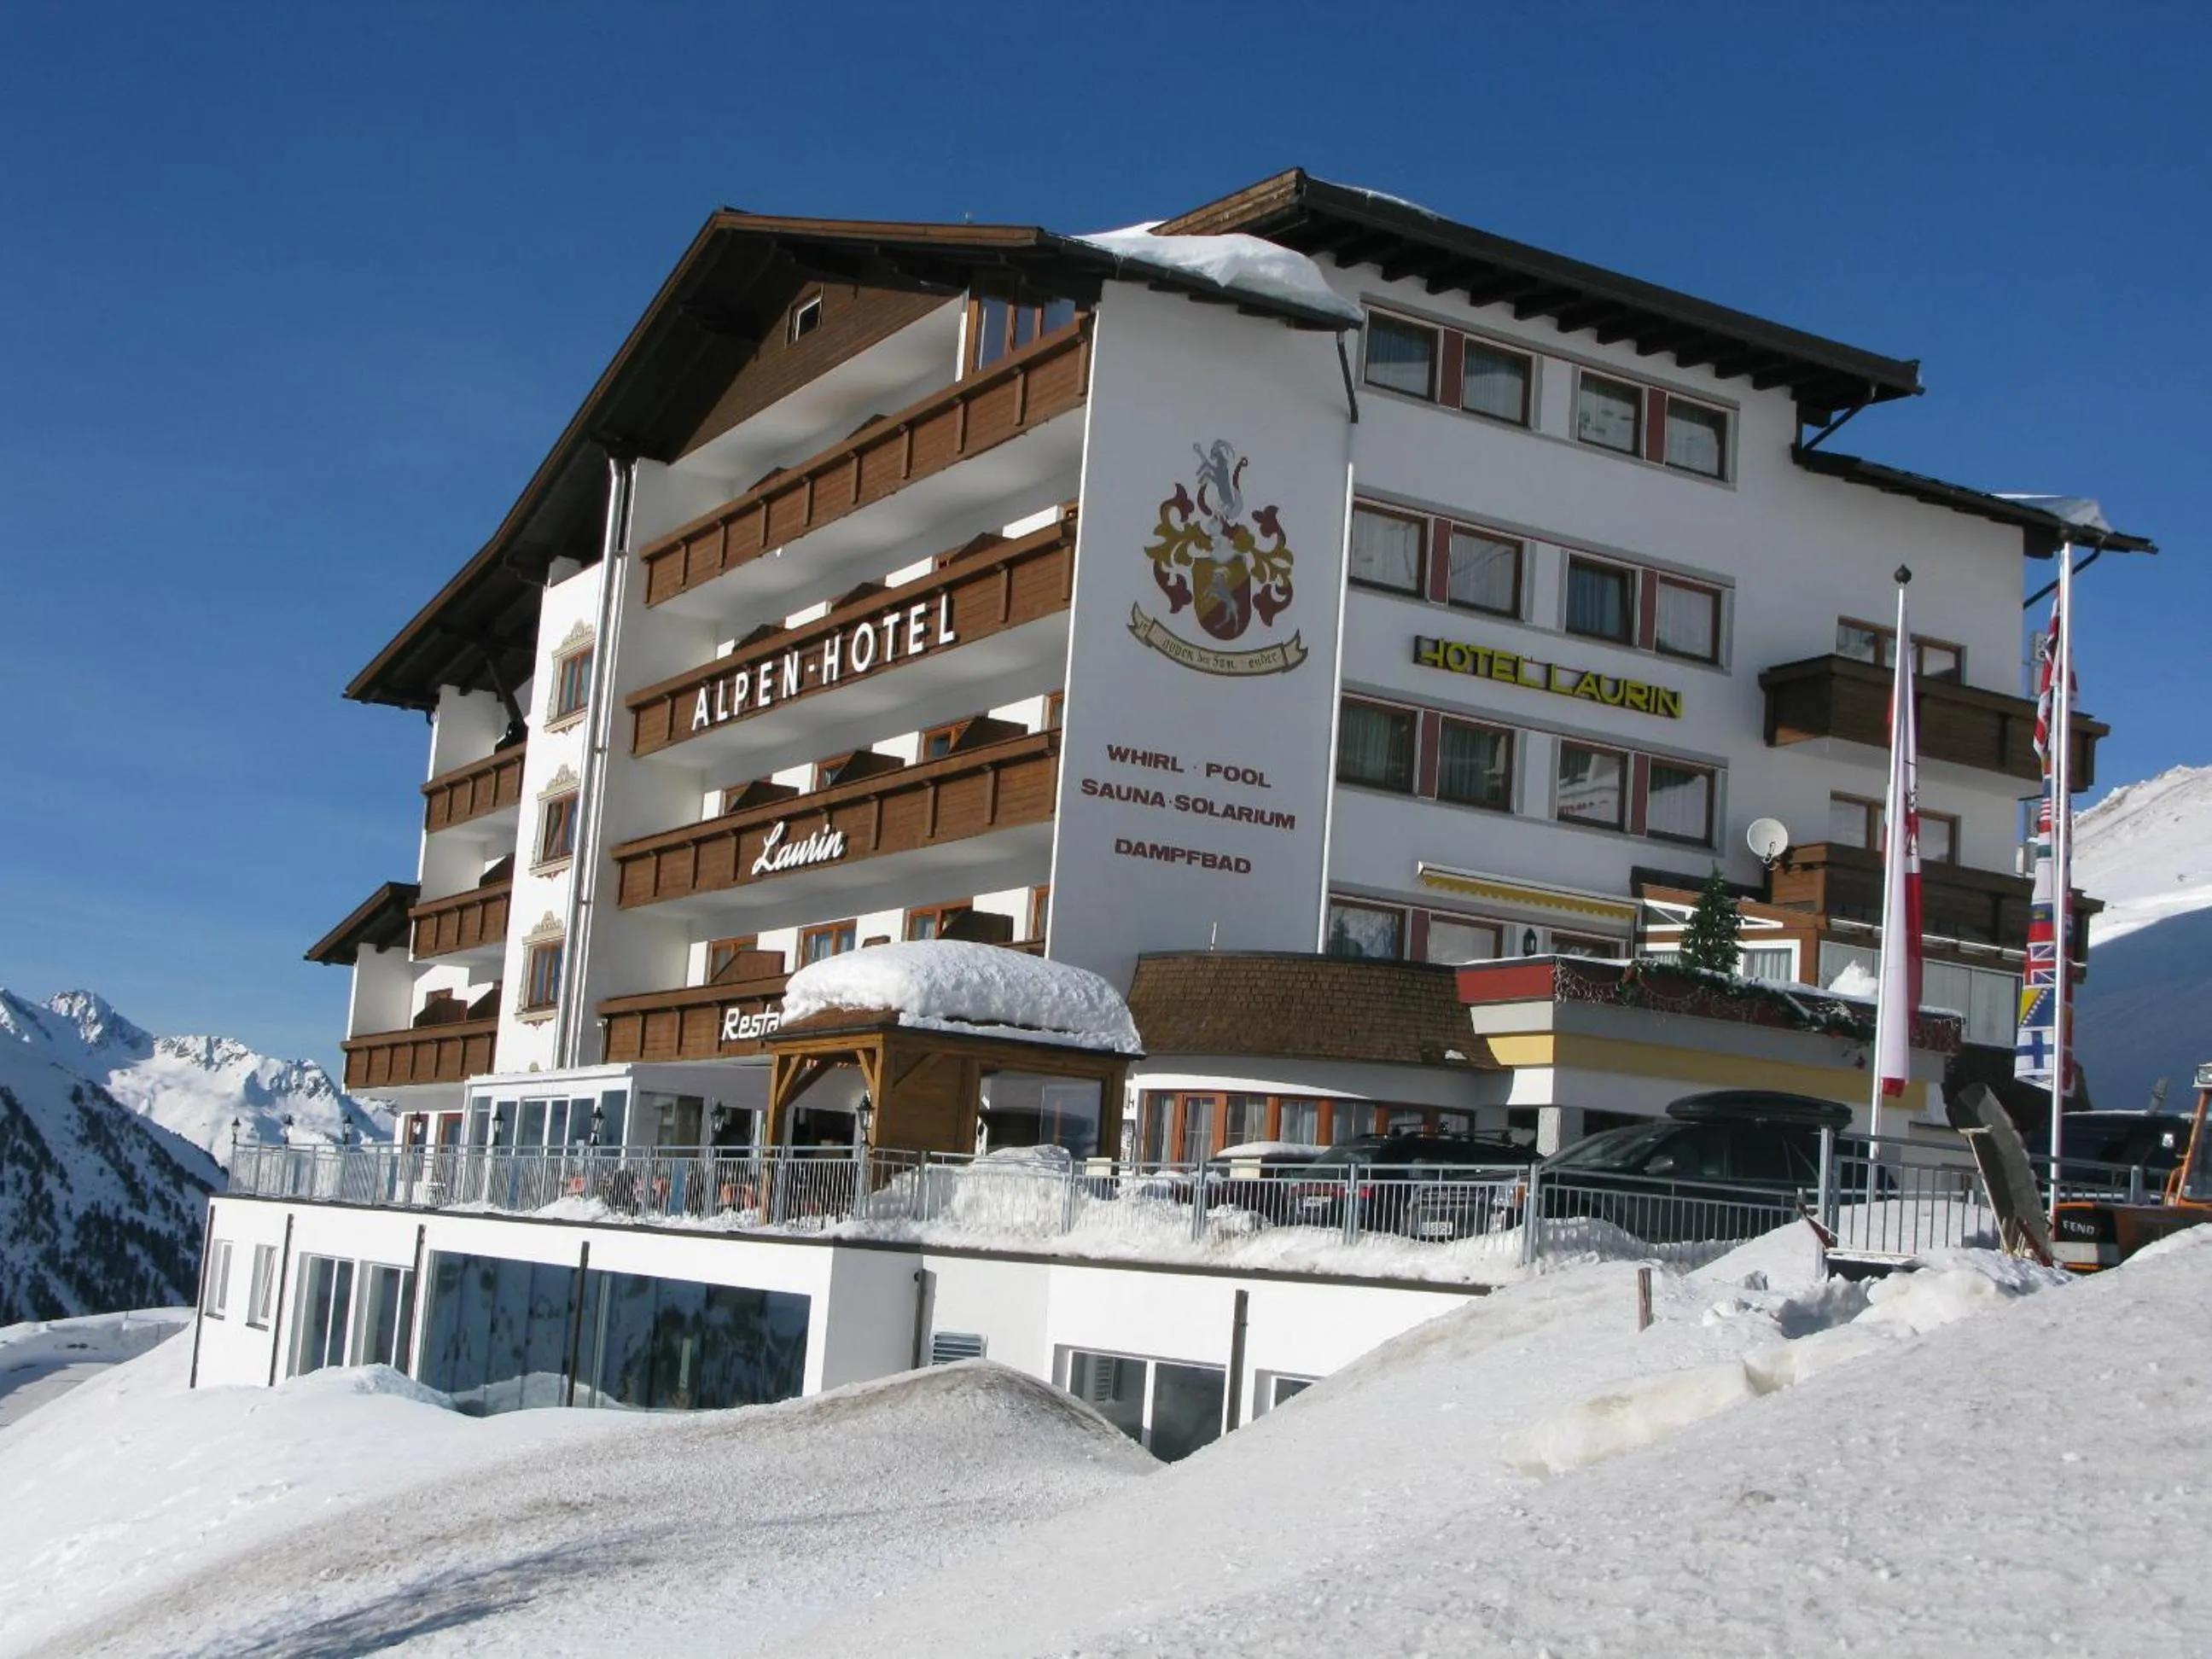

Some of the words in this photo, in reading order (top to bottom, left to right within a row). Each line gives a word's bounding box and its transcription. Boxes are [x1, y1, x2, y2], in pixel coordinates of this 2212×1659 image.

[1413, 635, 1545, 689] HOTEL
[1546, 662, 1682, 719] LAURIN
[1107, 744, 1185, 772] WHIRL
[1205, 762, 1272, 789] POOL
[752, 820, 845, 876] Laurin
[1115, 838, 1252, 875] DAMPFBAD
[721, 1004, 779, 1041] Resta
